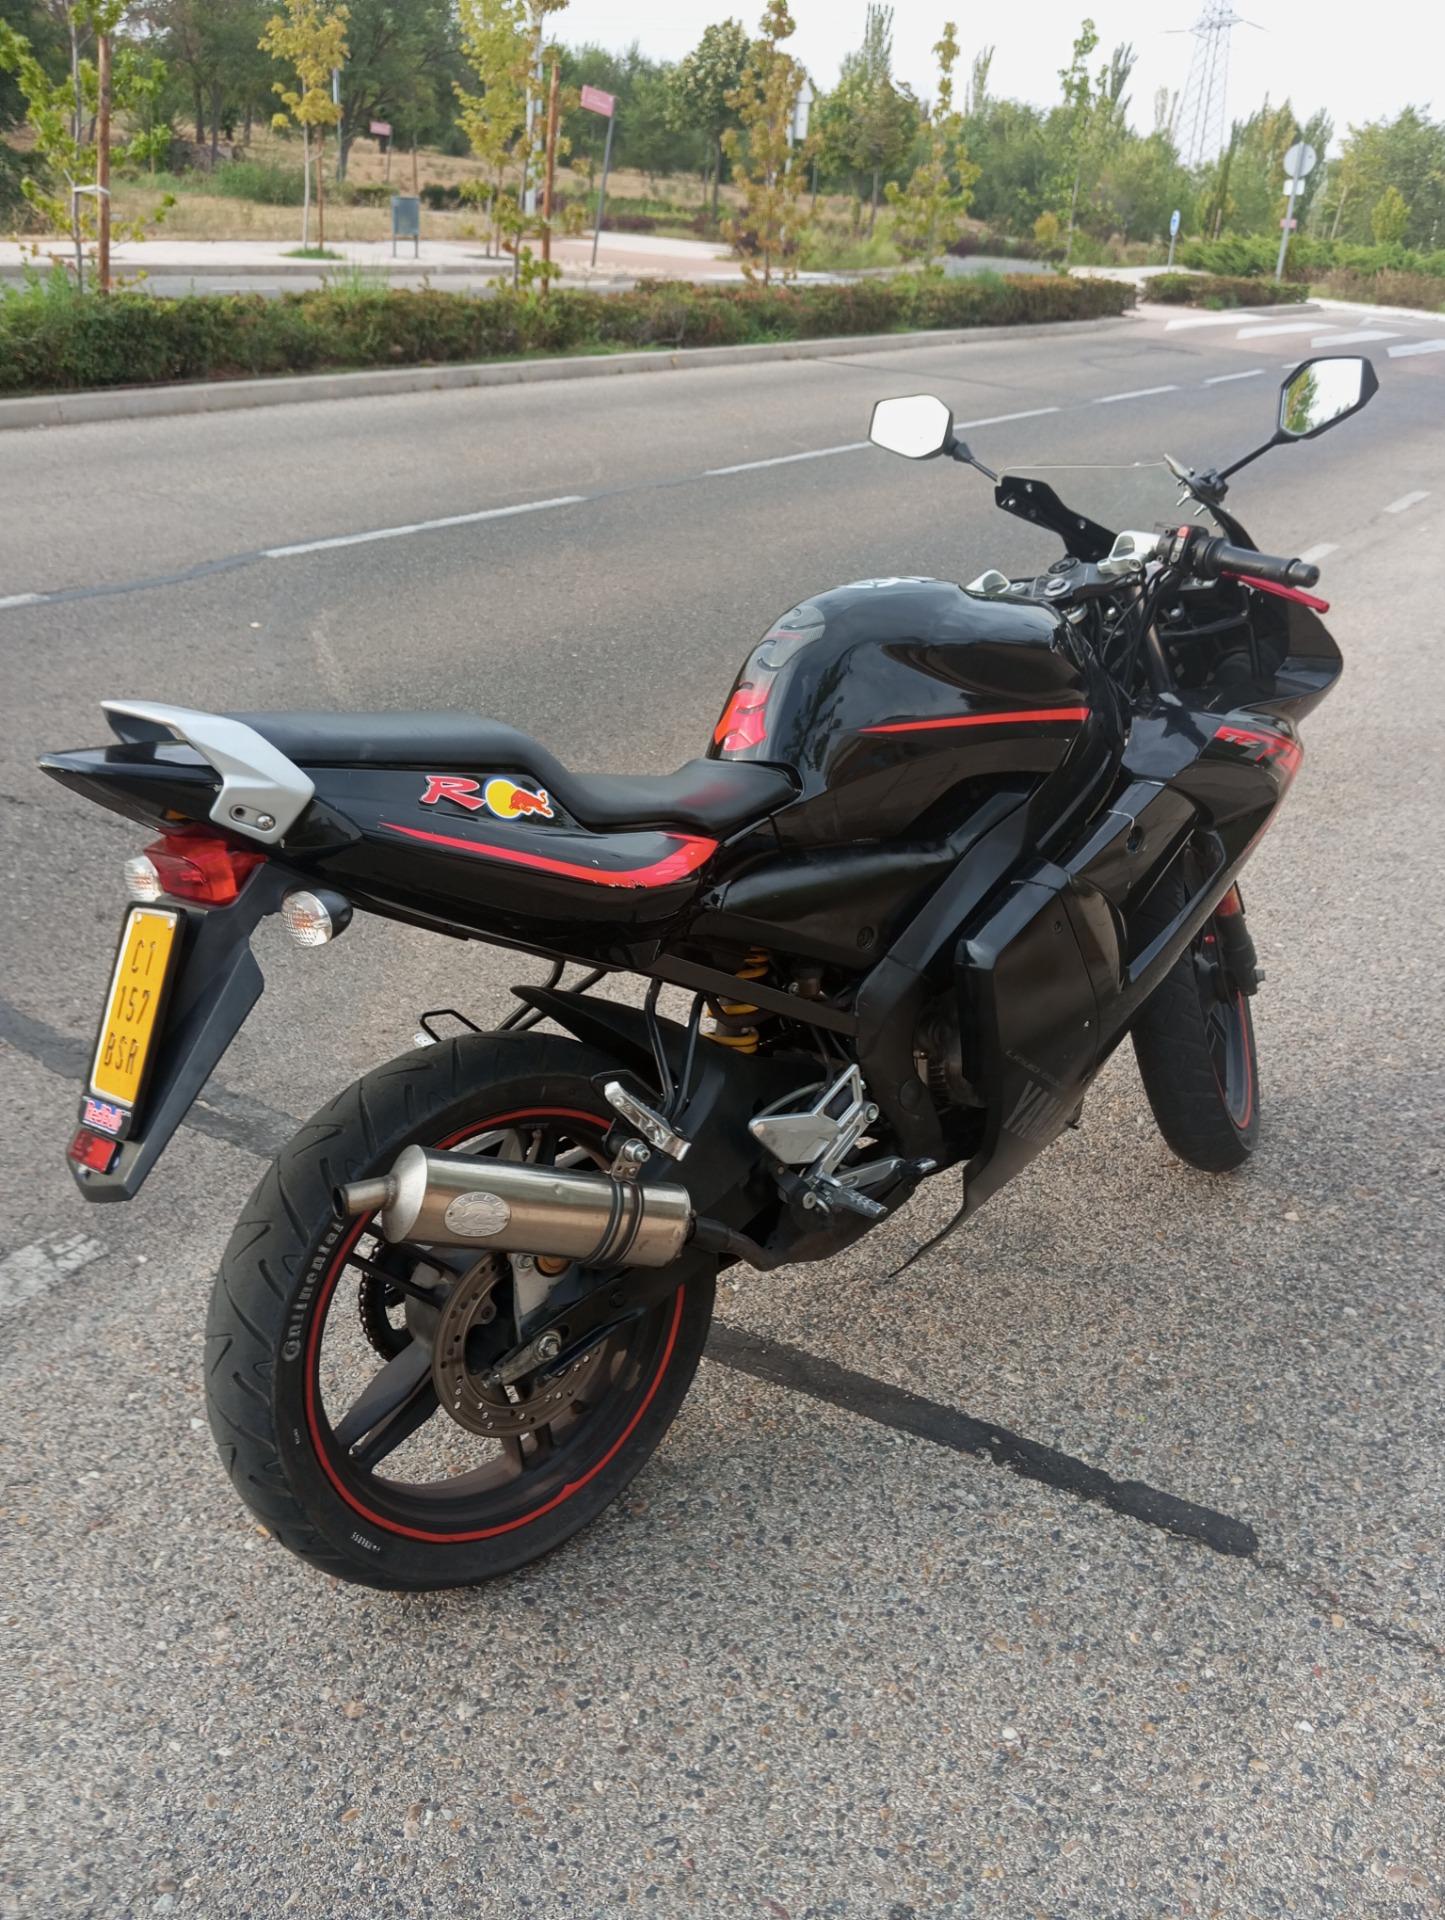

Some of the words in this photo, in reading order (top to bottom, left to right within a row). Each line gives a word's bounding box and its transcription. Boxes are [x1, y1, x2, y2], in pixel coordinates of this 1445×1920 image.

[132, 940, 157, 976] C1
[117, 985, 151, 1024] 157
[103, 1032, 140, 1075] BSR
